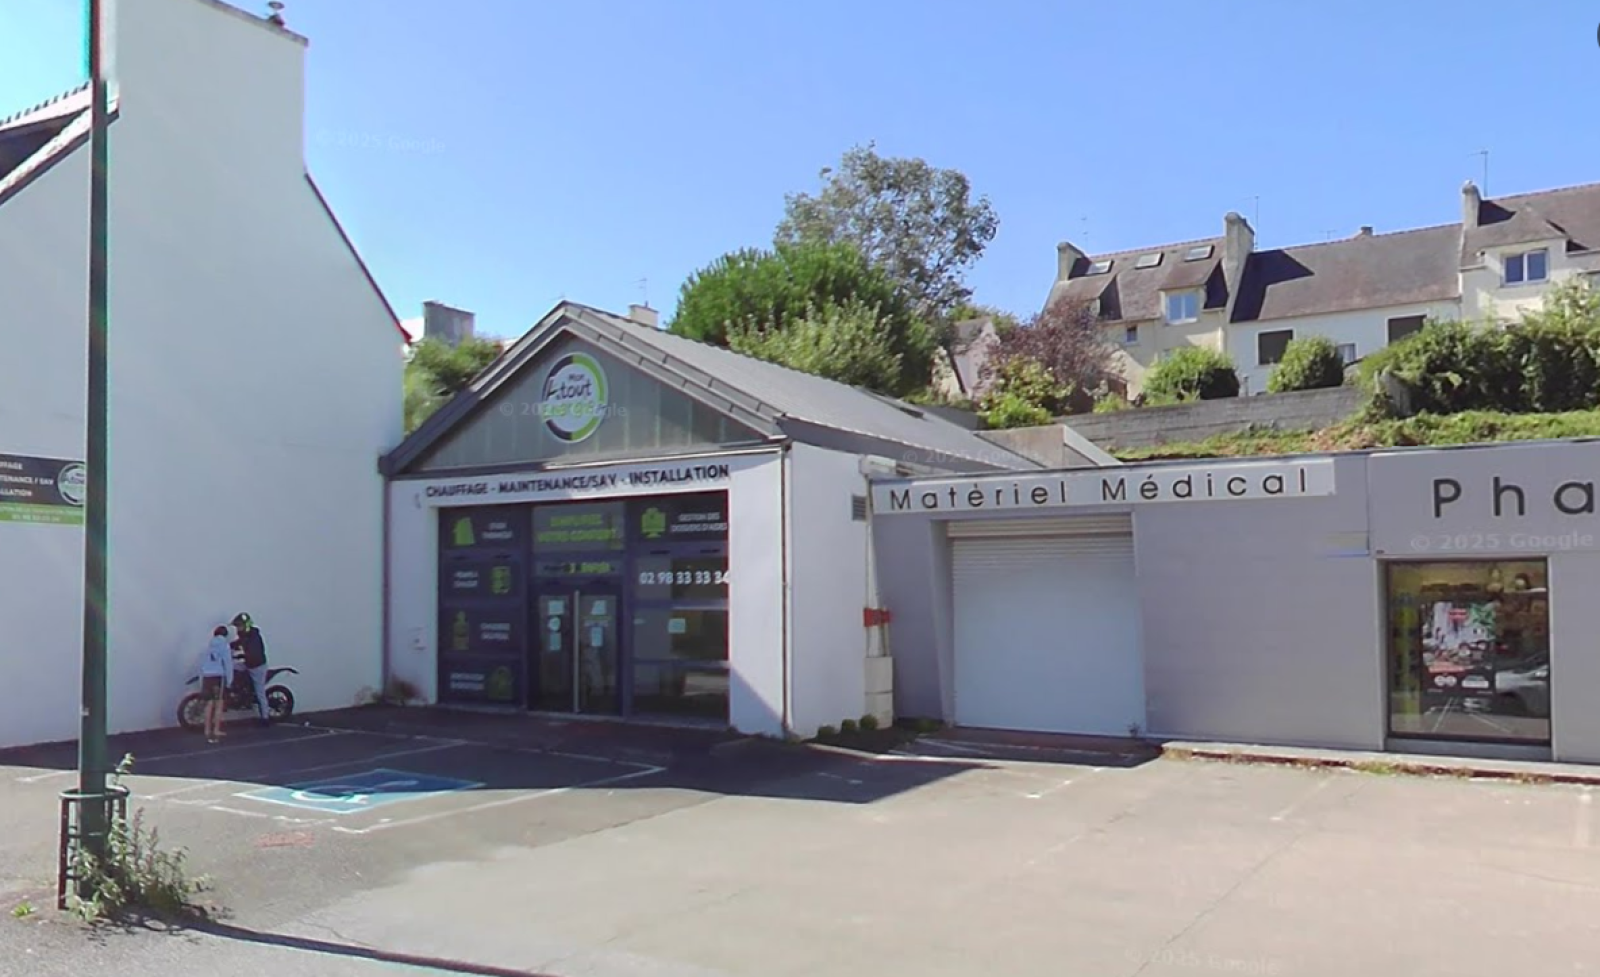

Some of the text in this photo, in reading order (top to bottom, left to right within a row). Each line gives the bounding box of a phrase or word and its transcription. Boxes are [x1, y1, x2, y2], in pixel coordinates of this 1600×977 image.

[426, 482, 489, 497] CHAUFFAGE
[629, 463, 730, 485] INSTALLATION
[1101, 467, 1306, 501] Médical
[1432, 476, 1595, 519] Pha
[639, 570, 655, 586] 02
[657, 570, 674, 586] 98
[676, 570, 693, 586] 33
[695, 570, 712, 586] 33
